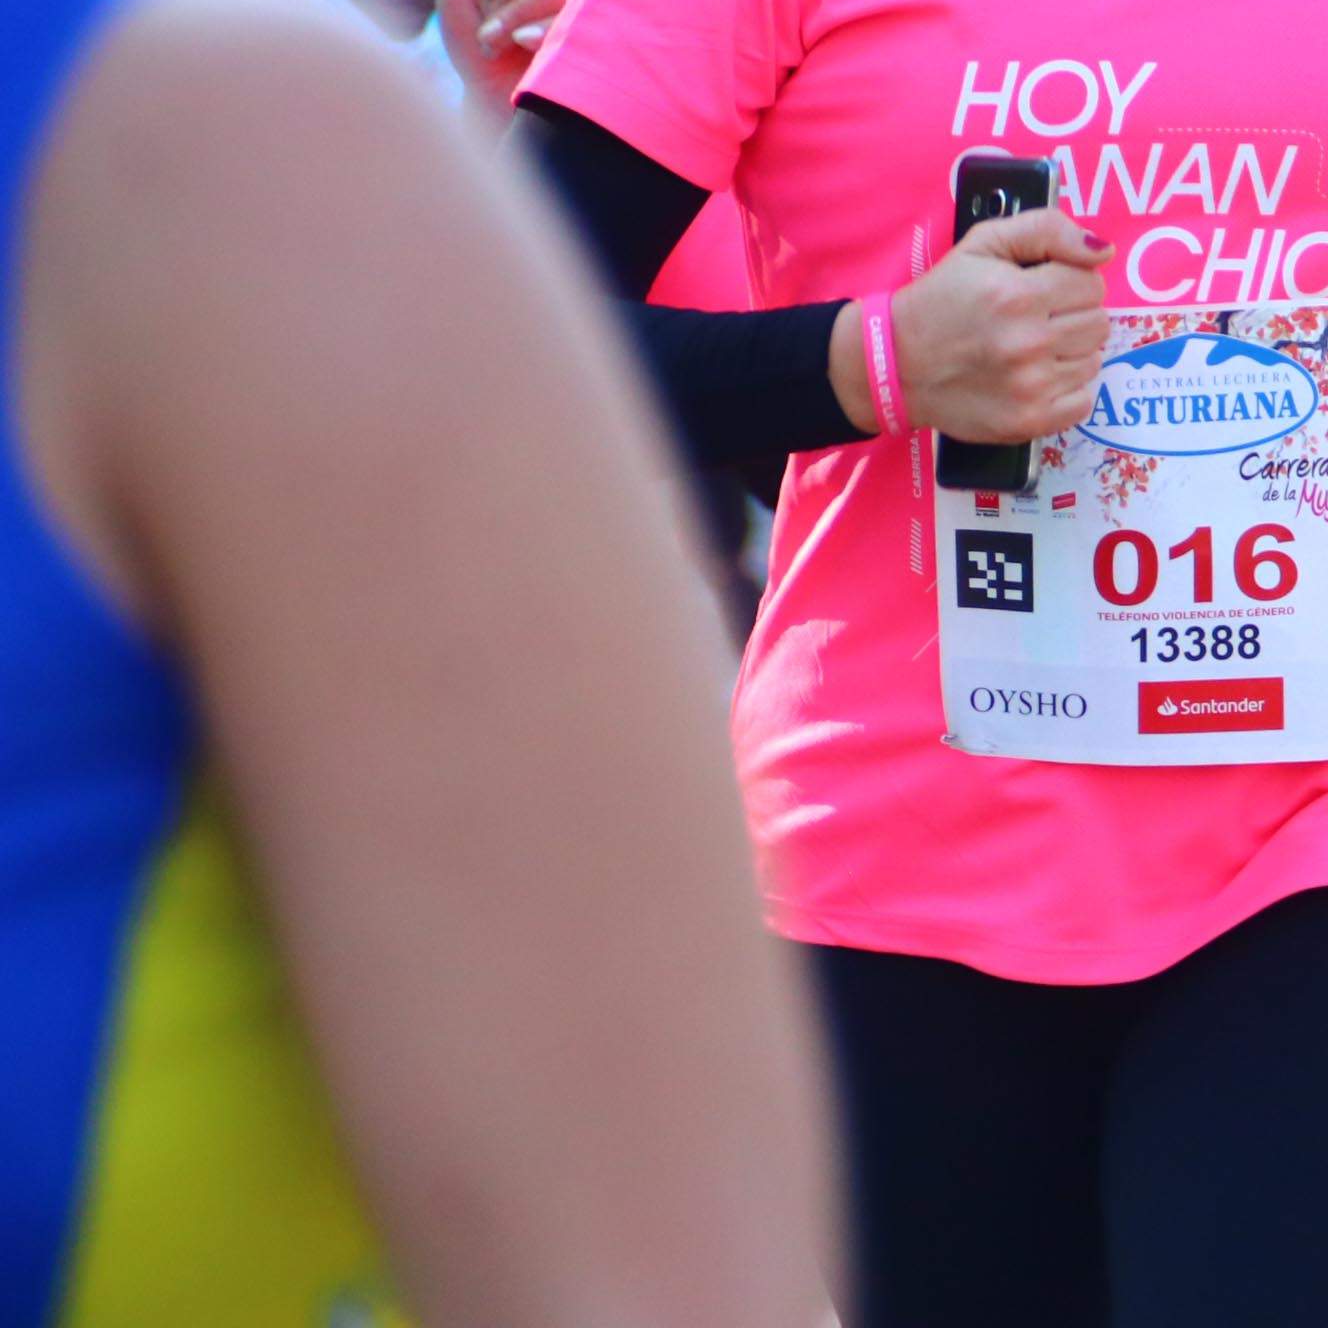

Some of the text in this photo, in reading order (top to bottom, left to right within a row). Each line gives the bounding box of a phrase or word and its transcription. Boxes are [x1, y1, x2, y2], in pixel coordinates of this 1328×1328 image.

[951, 59, 1157, 137] HOY
[1126, 371, 1292, 390] CENTRAL LECHERA
[1086, 382, 1300, 426] ASTURIANA
[910, 436, 923, 499] CARRERA
[1262, 482, 1281, 502] de
[1283, 481, 1297, 502] la
[1092, 522, 1300, 608] 016
[1097, 606, 1296, 622] TELÉFONO VIOLENCIA DE GÉNERO
[1131, 623, 1262, 664] 13388
[969, 686, 1089, 721] OYSHO
[1180, 697, 1266, 717] Santander
